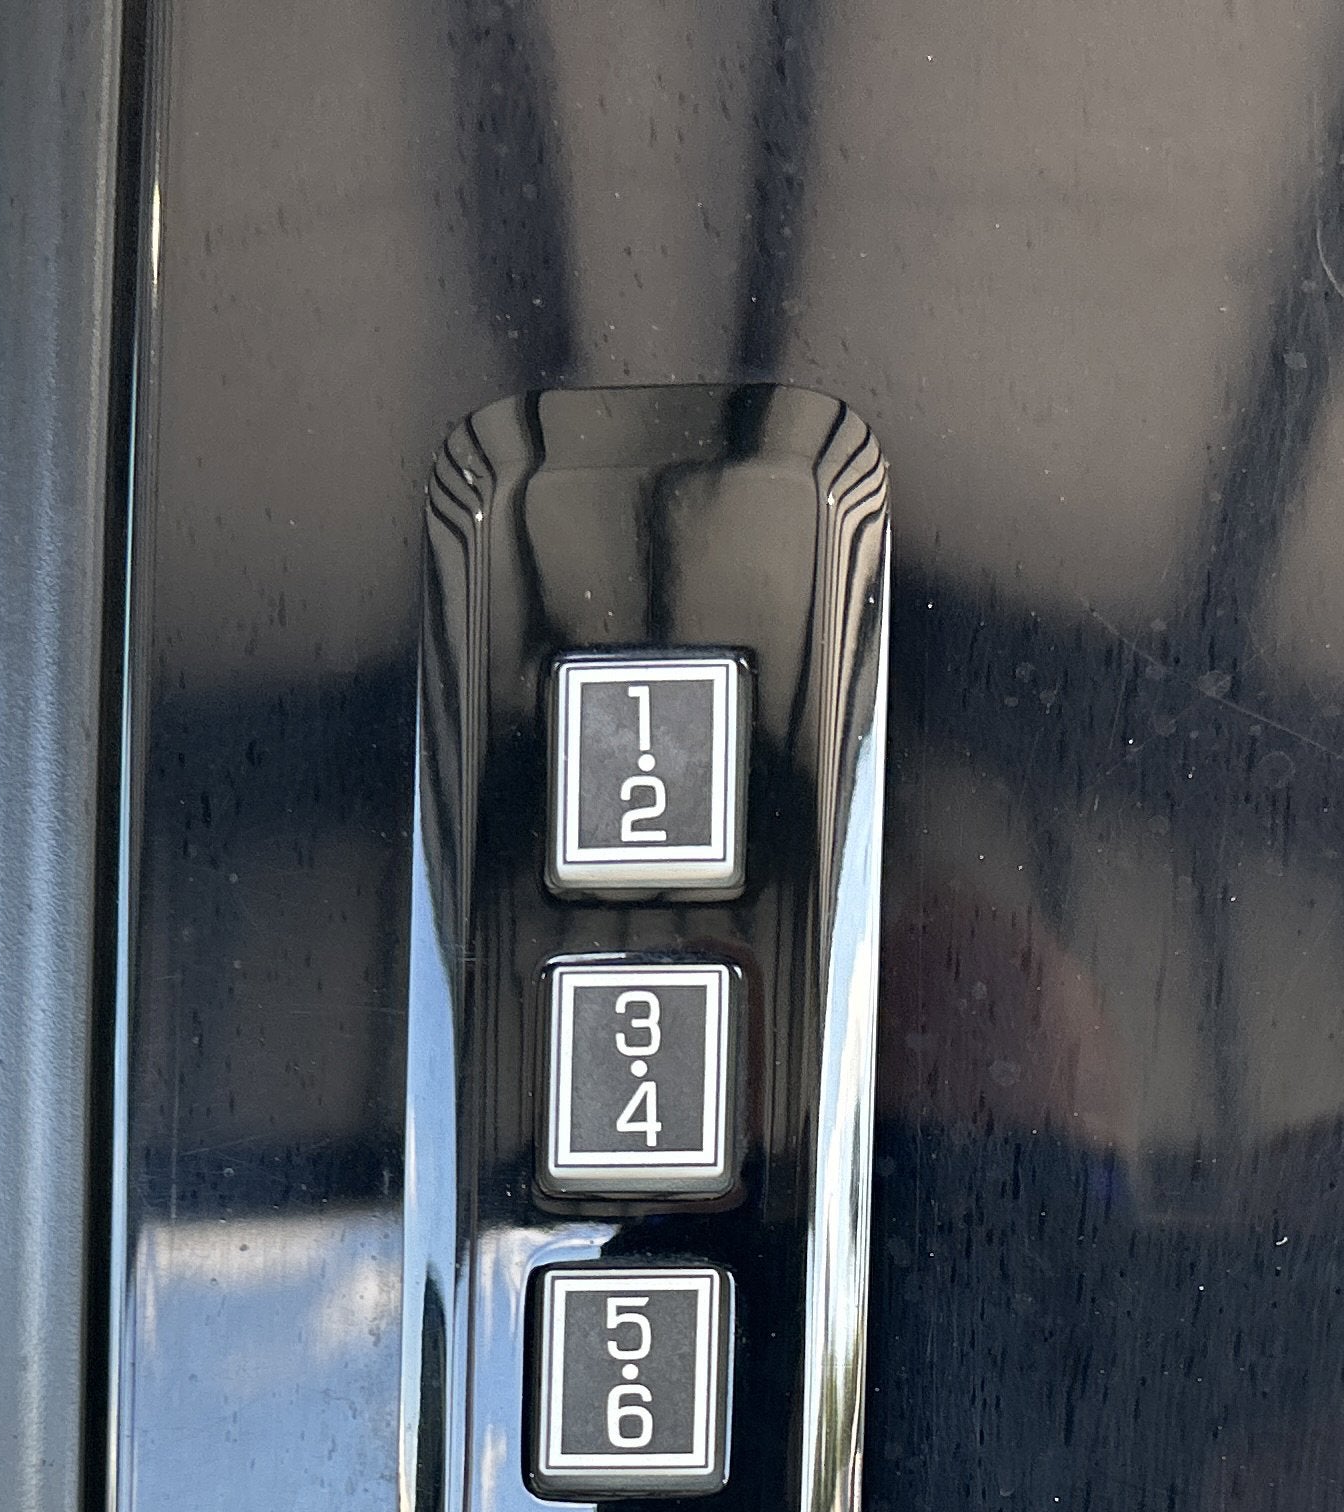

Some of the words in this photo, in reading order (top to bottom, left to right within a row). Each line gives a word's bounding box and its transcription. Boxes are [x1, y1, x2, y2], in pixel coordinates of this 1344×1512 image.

[628, 686, 650, 751] 1
[621, 776, 667, 842] 2
[615, 990, 661, 1057] 3
[616, 1081, 662, 1147] 4
[606, 1296, 652, 1361] 5
[606, 1384, 653, 1448] 6
